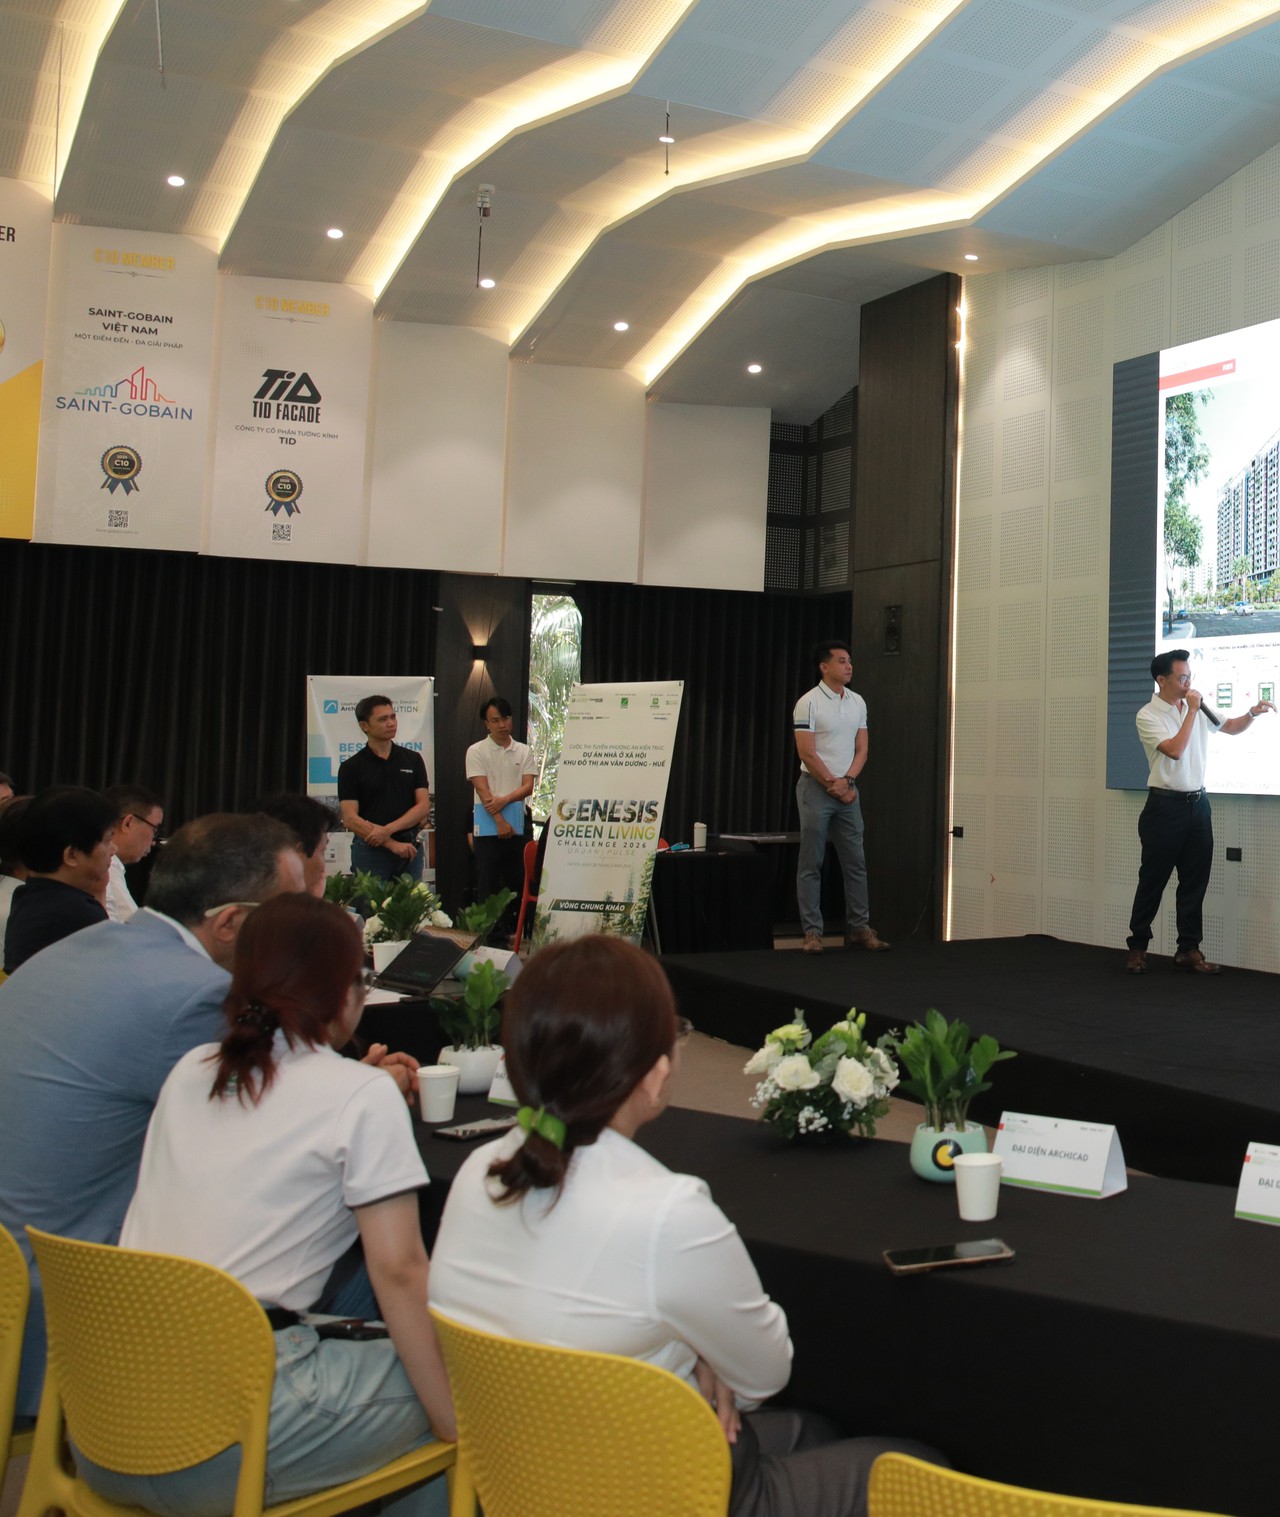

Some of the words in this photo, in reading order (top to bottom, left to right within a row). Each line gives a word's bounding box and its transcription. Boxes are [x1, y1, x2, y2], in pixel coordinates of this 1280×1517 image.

[88, 307, 173, 324] SAINT-GOBAIN
[102, 322, 128, 334] VIỆT
[131, 325, 158, 335] NAM
[163, 341, 184, 349] PHÁP
[56, 396, 193, 420] SAINT-GOBAIN
[253, 401, 271, 419] TID
[276, 403, 321, 423] FACADE
[279, 437, 296, 445] TID
[652, 759, 666, 767] HUẾ
[556, 799, 659, 824] GENESIS
[553, 824, 604, 839] GREEN
[608, 825, 656, 840] LIVING
[557, 839, 617, 848] CHALLENGE
[559, 901, 579, 909] VÒNG
[604, 903, 625, 911] KHẢO
[1027, 1145, 1047, 1156] DIỆN
[1048, 1149, 1089, 1162] ARCHICAD
